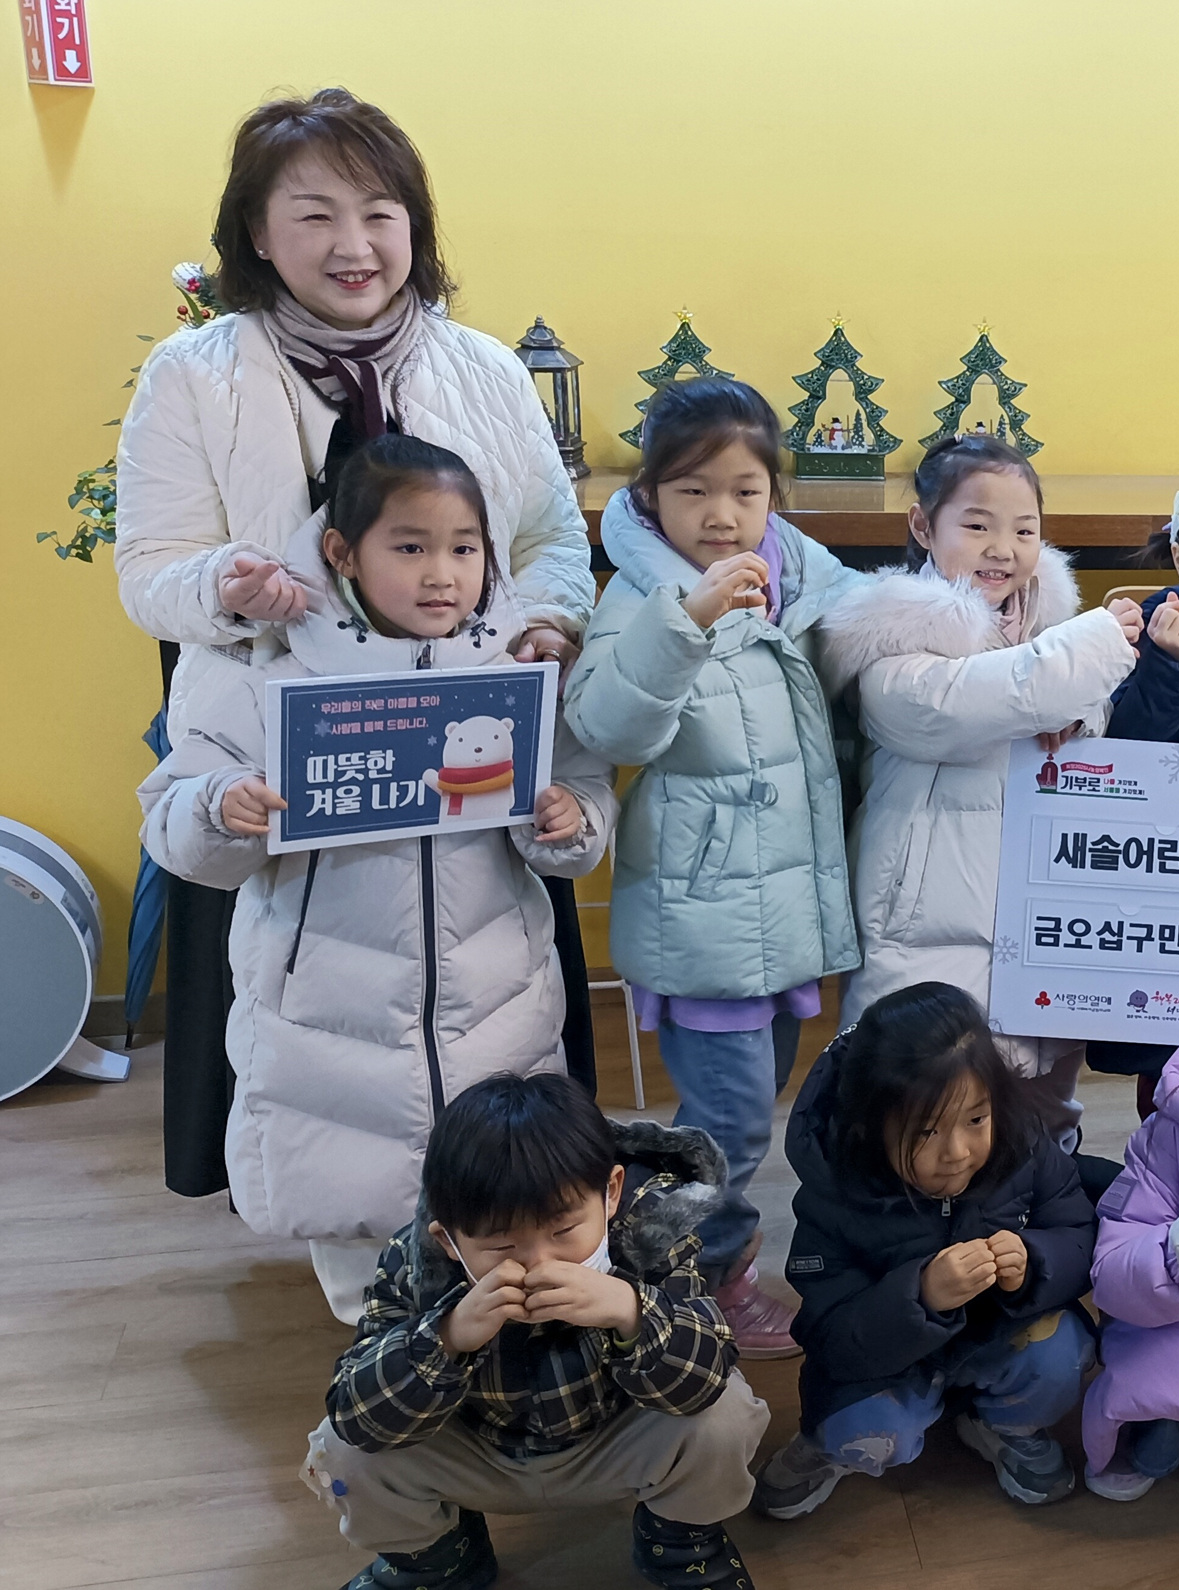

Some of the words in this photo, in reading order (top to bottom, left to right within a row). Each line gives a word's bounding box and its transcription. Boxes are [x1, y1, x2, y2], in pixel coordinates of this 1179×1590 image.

[321, 701, 362, 714] 우리들의
[364, 699, 385, 711] 작은
[388, 697, 418, 710] 마음을
[420, 695, 440, 708] 모아
[331, 722, 361, 735] 사랑을
[364, 720, 384, 733] 듬뿍
[386, 717, 429, 732] 드립니다.
[306, 749, 396, 784] 따뜻한
[1060, 774, 1101, 793] 기부로
[305, 784, 362, 818] 겨울
[371, 779, 425, 810] 나기
[1054, 993, 1112, 1007] 사랑의열매
